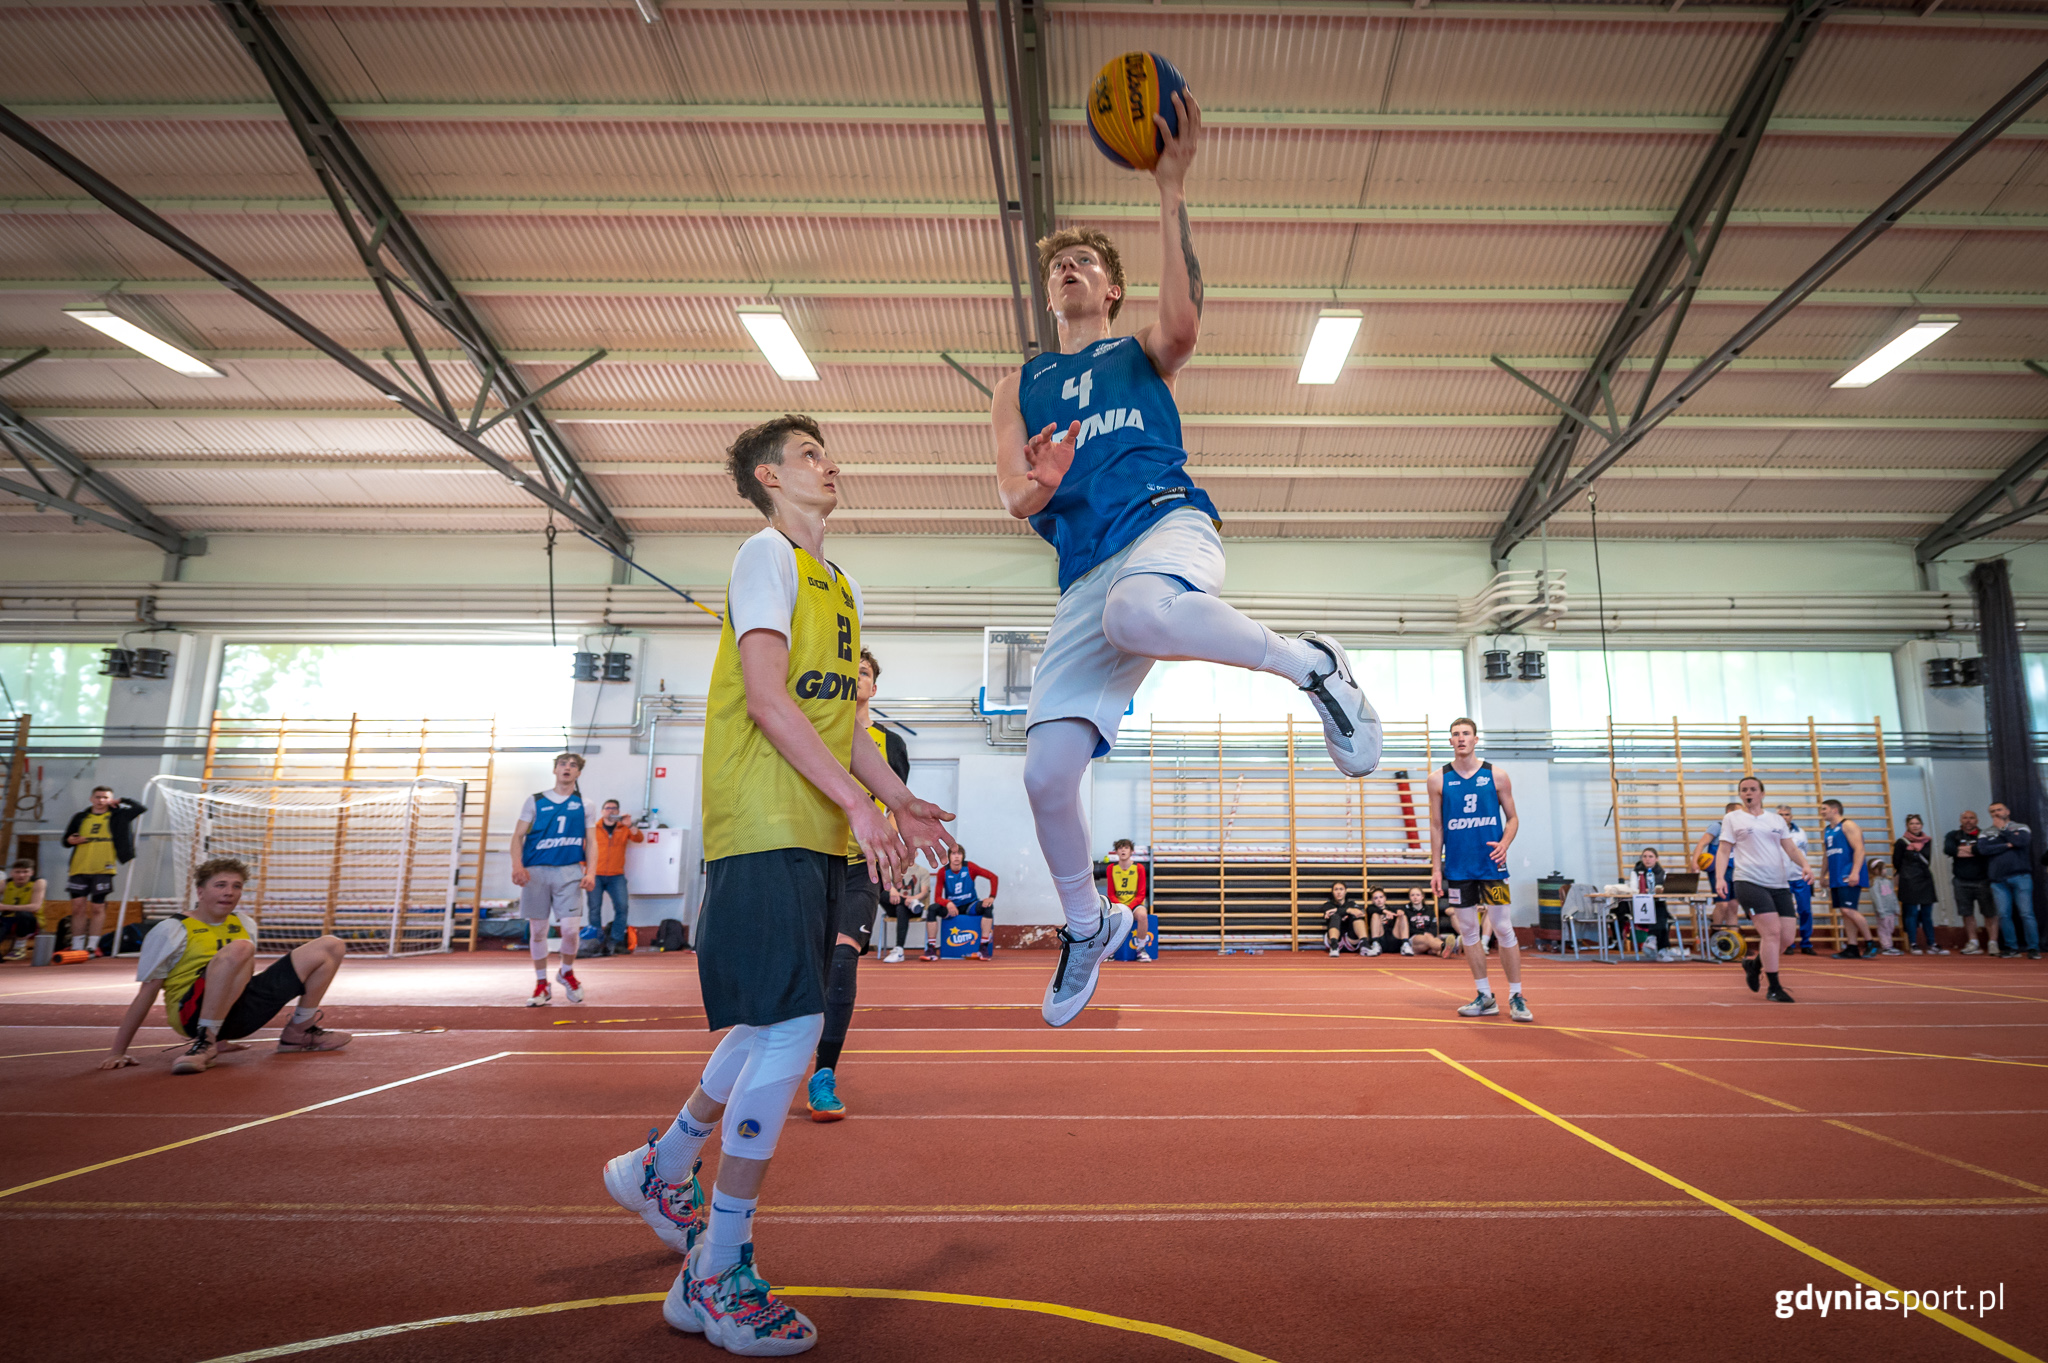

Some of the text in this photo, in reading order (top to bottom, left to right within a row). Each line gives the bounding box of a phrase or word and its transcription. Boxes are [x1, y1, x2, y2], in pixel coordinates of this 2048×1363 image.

[1062, 368, 1093, 409] 4
[1051, 408, 1145, 450] YNIA
[837, 613, 853, 663] 2
[1463, 793, 1478, 813] 3
[557, 815, 567, 834] 1
[1448, 816, 1497, 831] GDYNIA
[536, 837, 582, 850] GDYNIA
[1121, 878, 1129, 888] 3
[1640, 902, 1648, 914] 4
